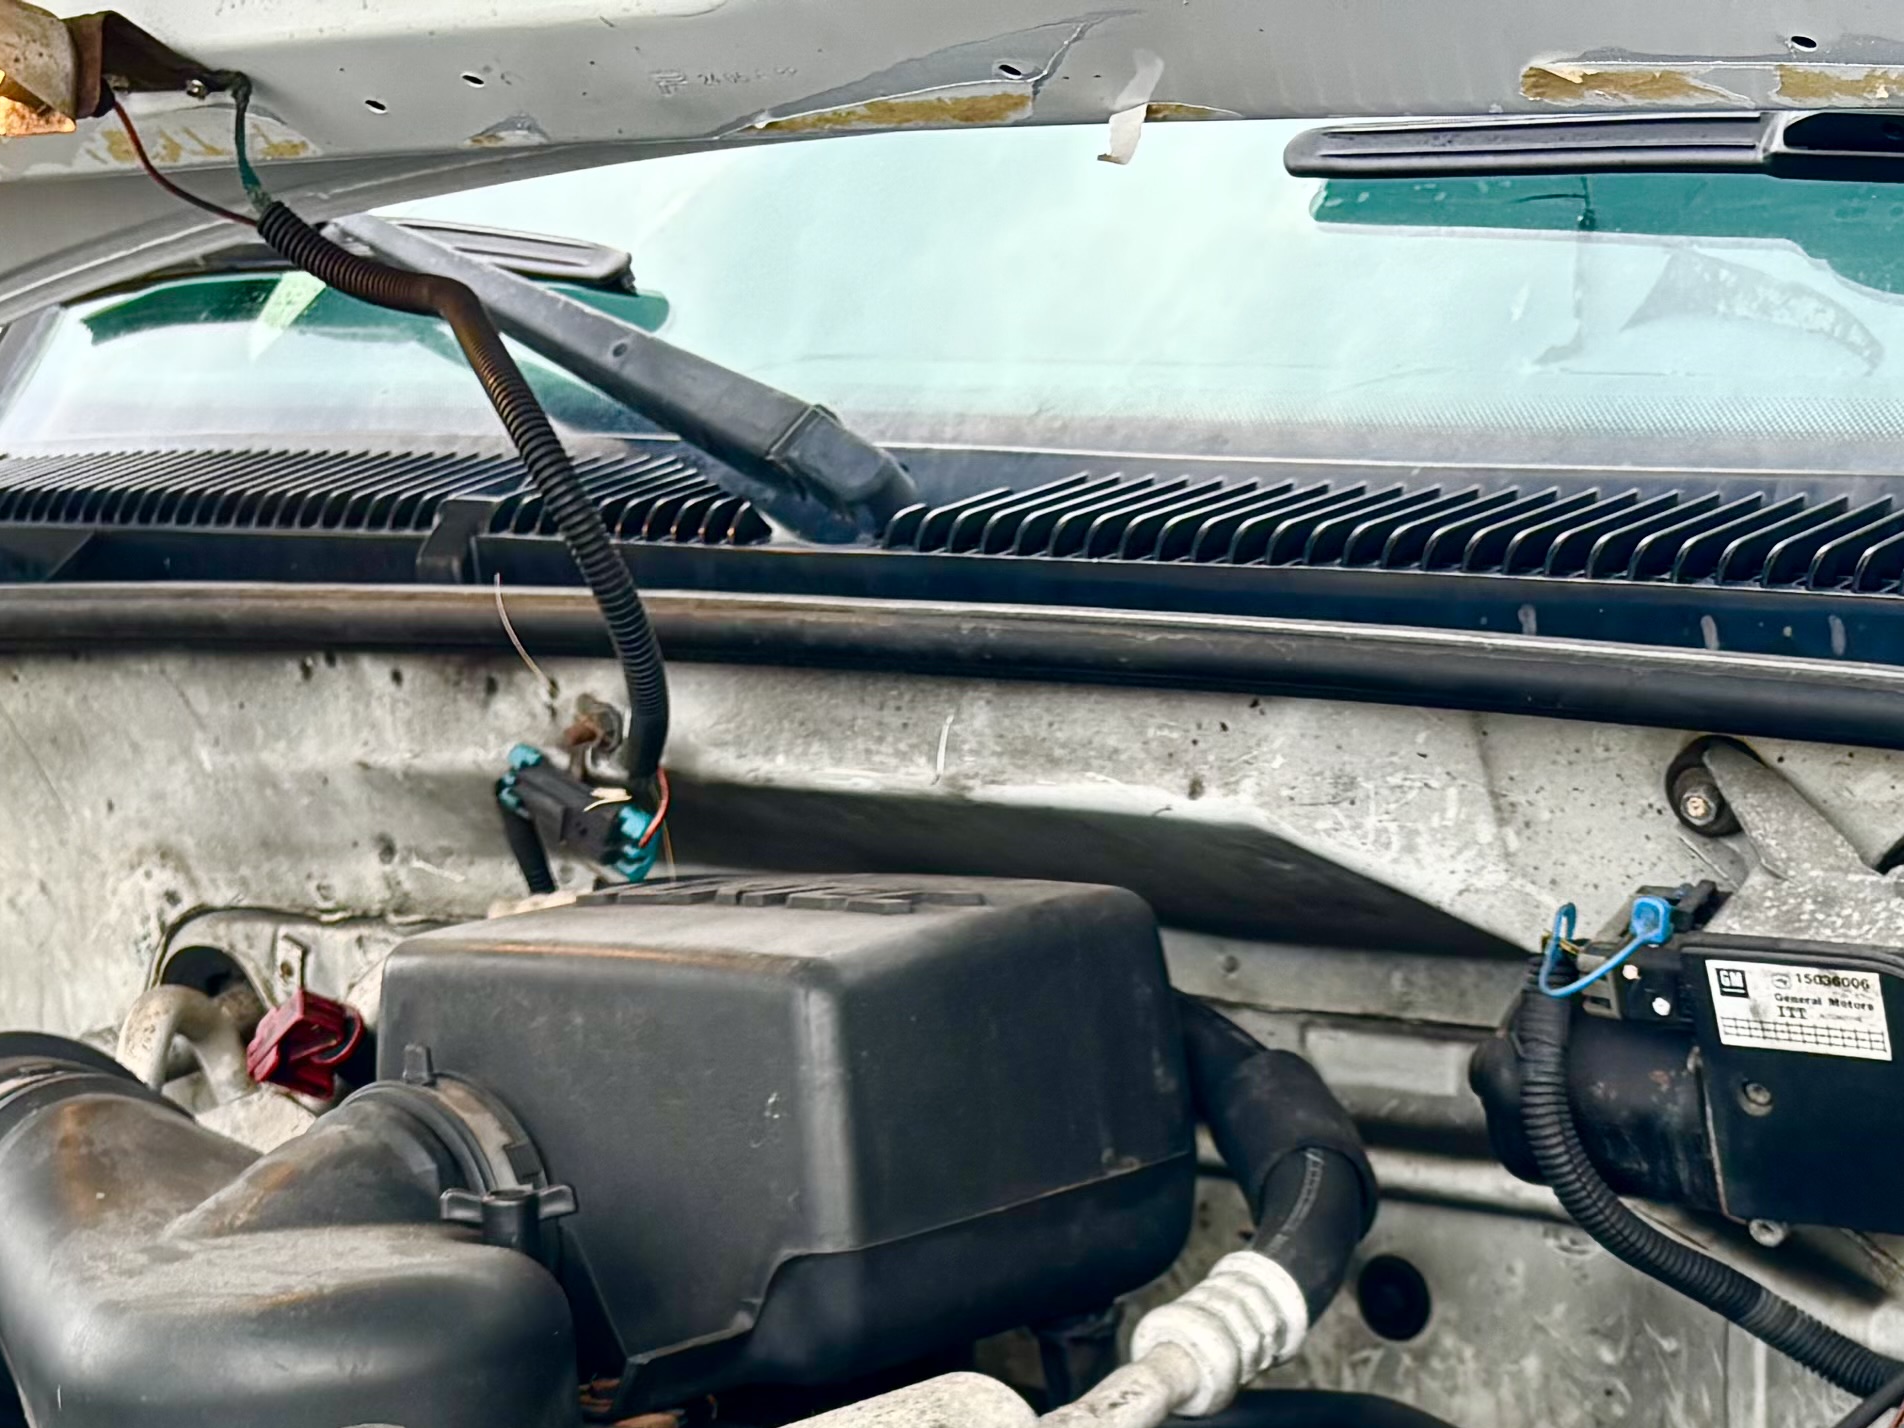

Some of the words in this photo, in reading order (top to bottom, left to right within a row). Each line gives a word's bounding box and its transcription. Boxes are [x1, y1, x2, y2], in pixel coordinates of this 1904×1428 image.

[1719, 970, 1744, 987] GM
[1774, 993, 1822, 1007] General
[1828, 997, 1874, 1011] Motors
[1777, 1006, 1807, 1019] ITT
